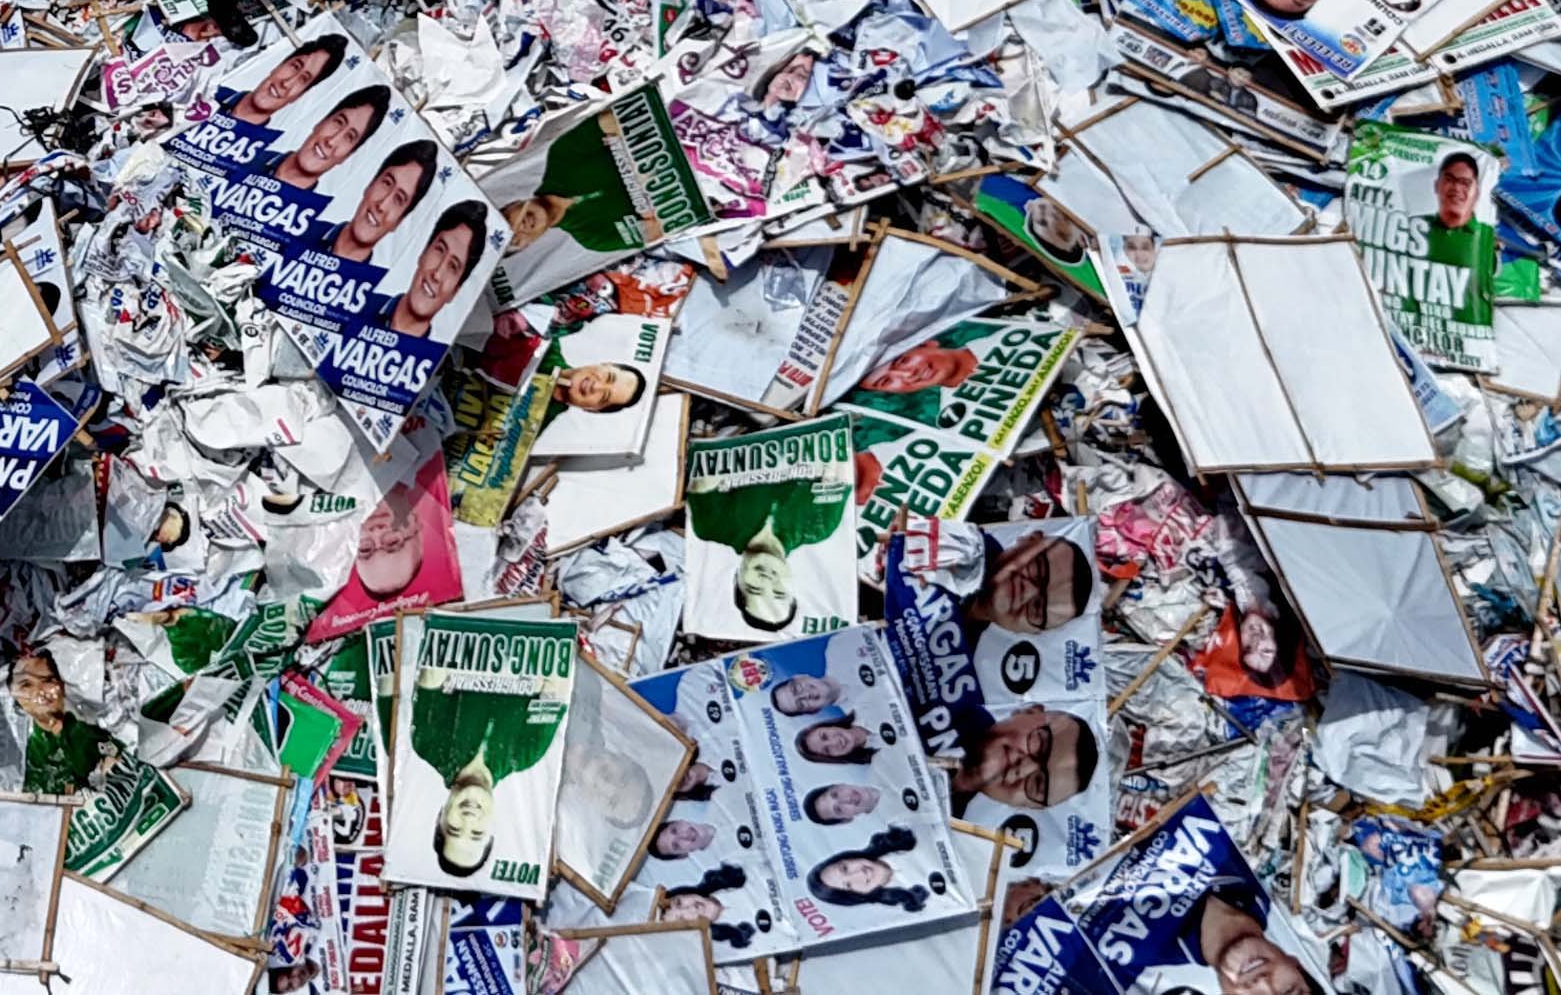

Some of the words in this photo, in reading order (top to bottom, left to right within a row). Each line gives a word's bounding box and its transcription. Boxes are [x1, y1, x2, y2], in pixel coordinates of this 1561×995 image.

[1281, 24, 1353, 72] RE-ELECT!
[614, 91, 673, 178] SUNTAY
[242, 173, 281, 194] ALFRED
[1361, 160, 1381, 180] 14
[211, 180, 322, 237] VARGAS
[647, 178, 696, 234] BONG
[1350, 182, 1393, 208] ATTY.
[1349, 208, 1431, 256] MIGS
[268, 250, 375, 313] VARGAS
[299, 249, 341, 272] ALFRED
[277, 292, 329, 317] COUNCILOR
[358, 324, 399, 347] ALFRED
[634, 322, 659, 364] VOTE!
[325, 334, 433, 394] VARGAS
[955, 326, 1031, 405] ENZO
[341, 374, 389, 398] COUNCILOR
[959, 328, 1063, 444] PINEDA
[692, 440, 787, 479] SUNTAY
[787, 430, 848, 464] BONG
[861, 437, 939, 530] ENZO
[422, 629, 510, 673] SUNTAY
[510, 635, 572, 677] BONG
[902, 606, 938, 700] CONGRESSMAN
[442, 671, 535, 695] CONGRESSMAN
[491, 858, 541, 884] VOTE!
[1099, 812, 1221, 967] VARGAS
[1170, 855, 1212, 917] ALFRED
[409, 892, 420, 923] RAM
[795, 898, 837, 939] VOTE!
